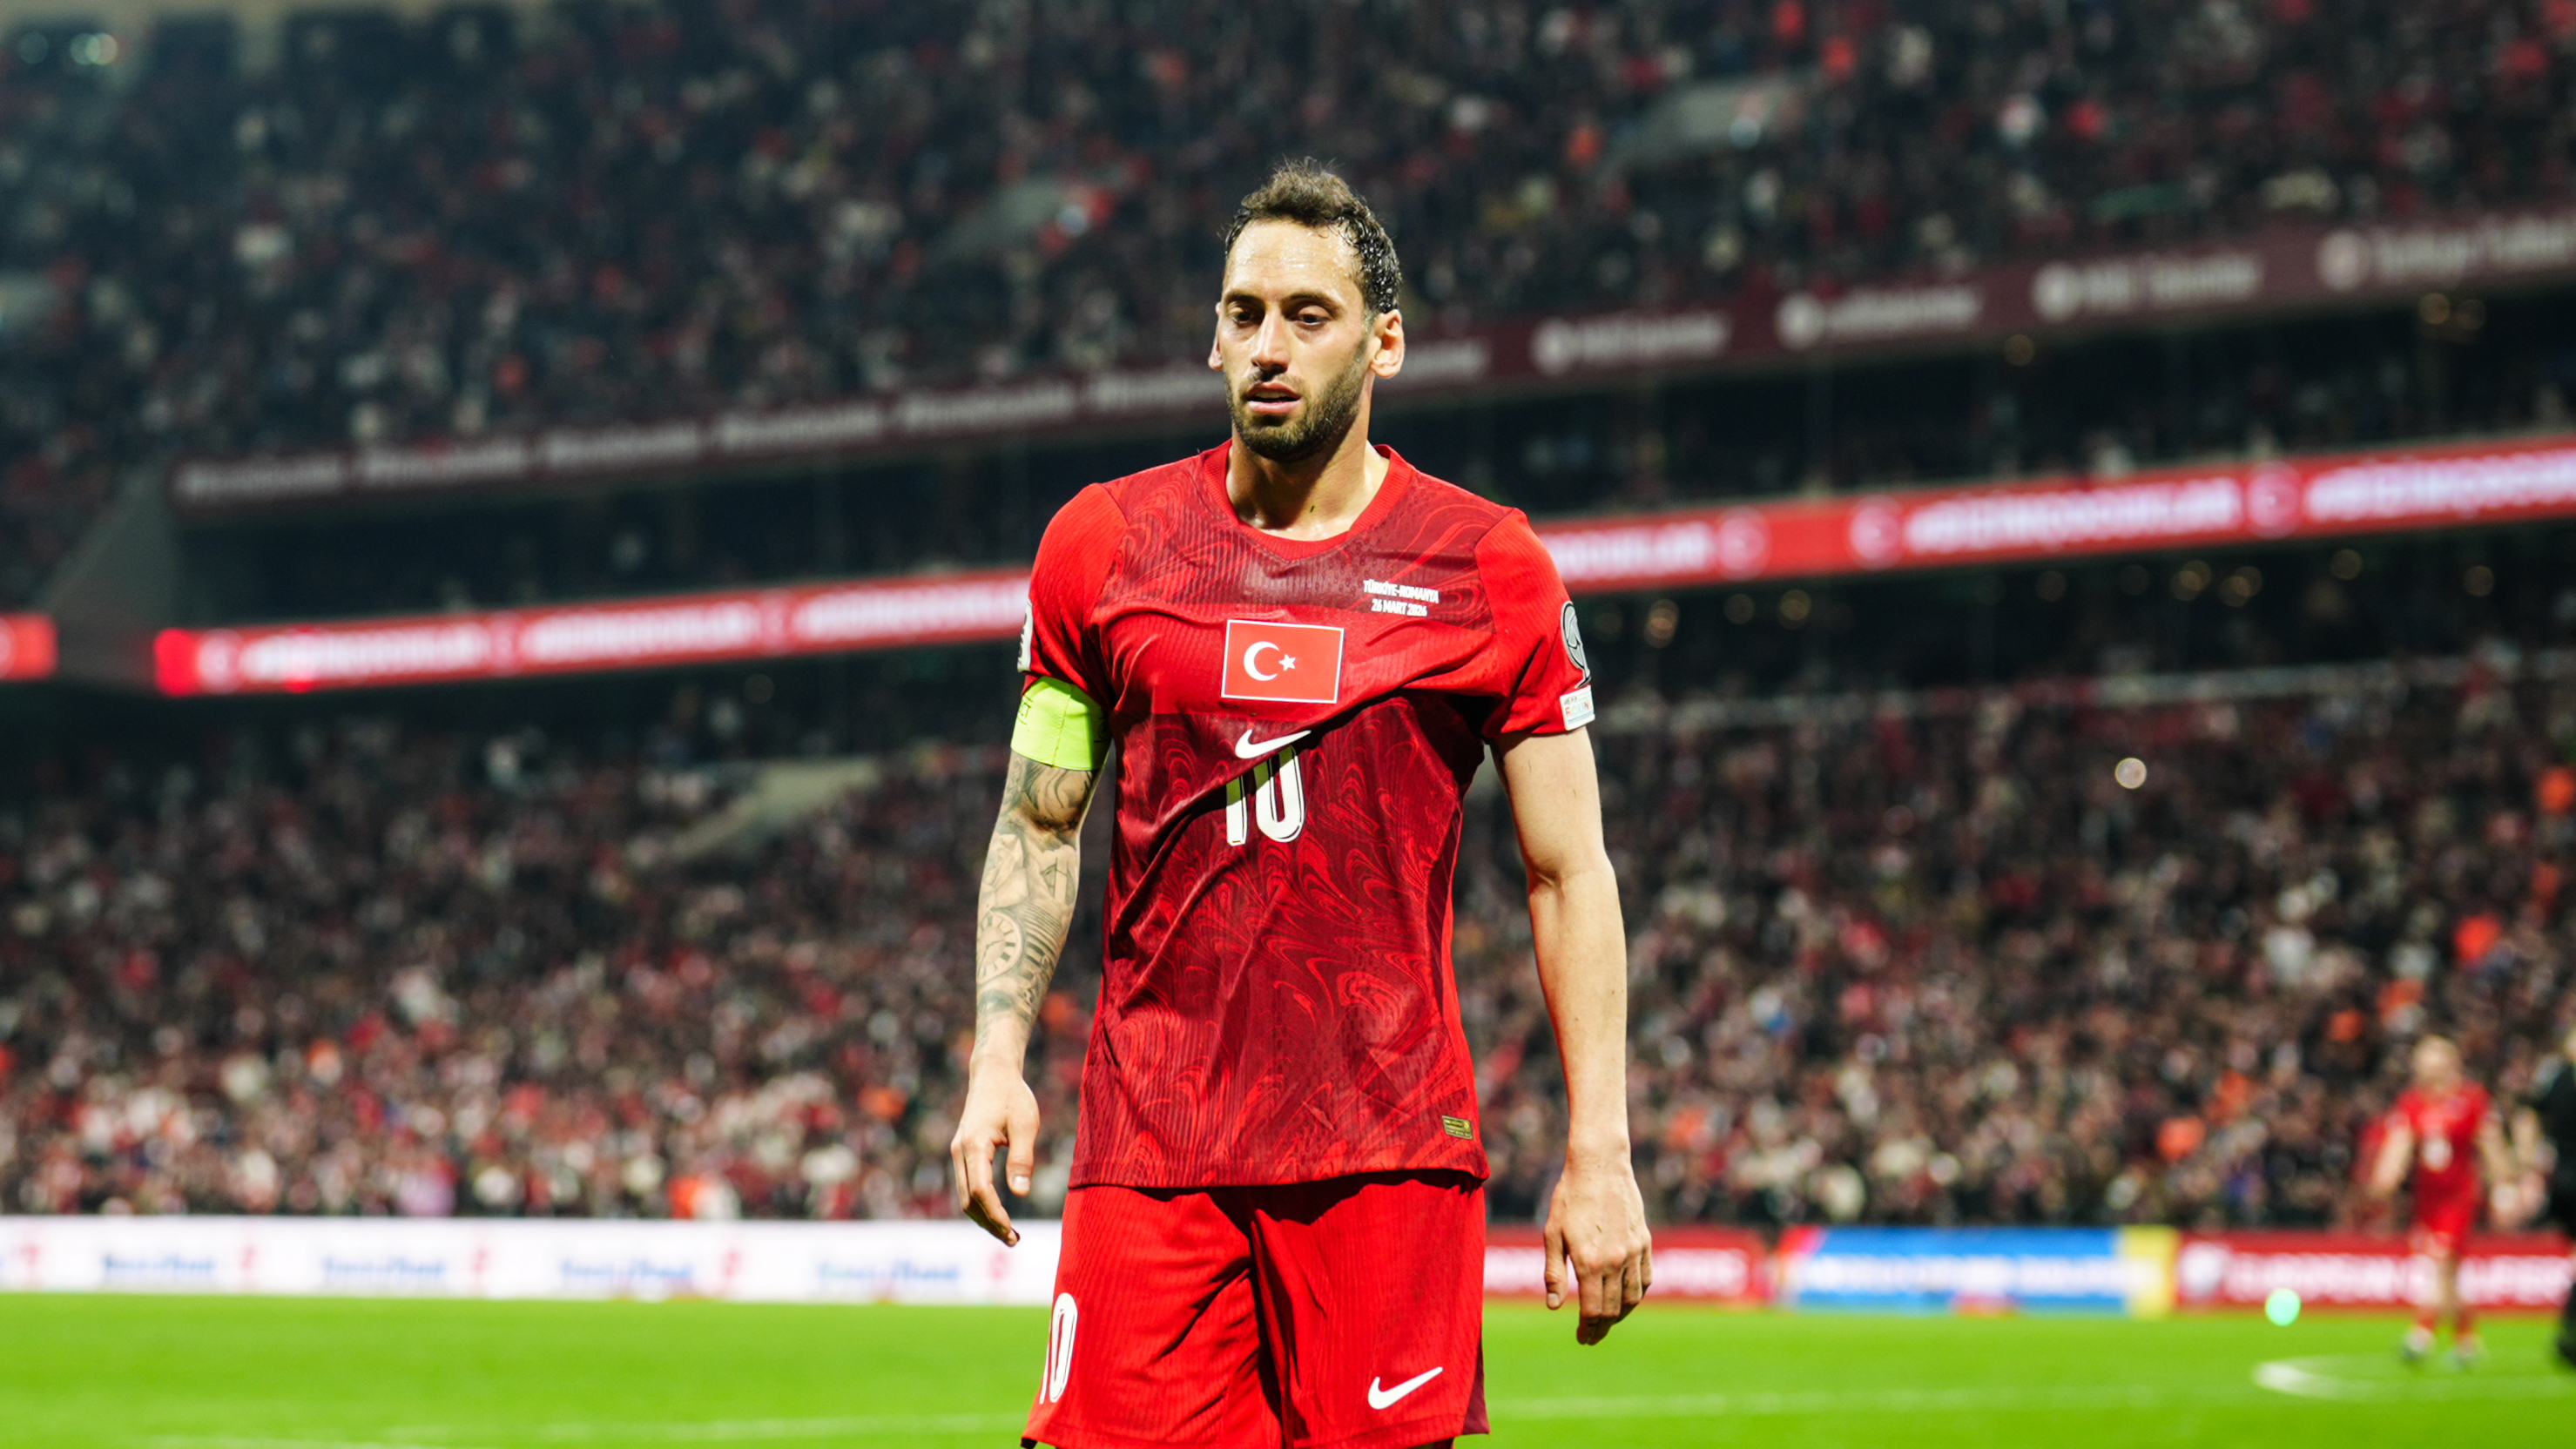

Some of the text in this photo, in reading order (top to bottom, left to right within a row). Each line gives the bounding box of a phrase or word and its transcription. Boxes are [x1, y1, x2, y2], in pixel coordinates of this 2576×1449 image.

[1363, 579, 1440, 603] TÜRKİYE-ROMANYA
[1371, 598, 1428, 617] 26 MART 2026
[1226, 746, 1305, 846] 10
